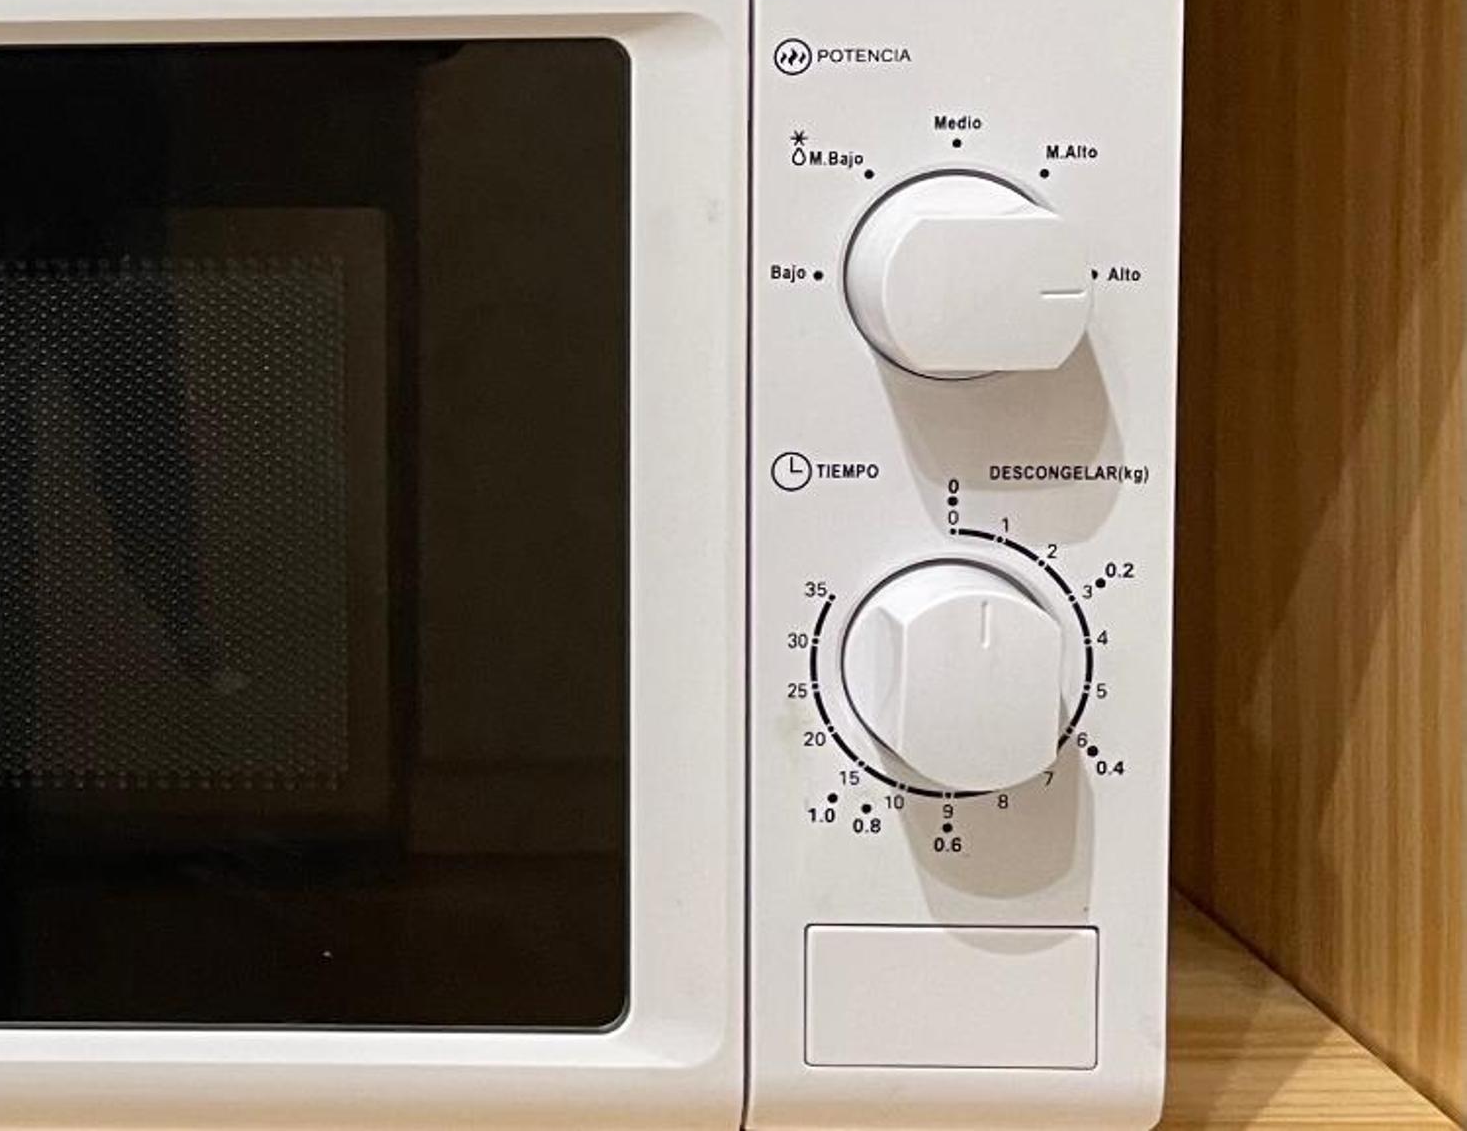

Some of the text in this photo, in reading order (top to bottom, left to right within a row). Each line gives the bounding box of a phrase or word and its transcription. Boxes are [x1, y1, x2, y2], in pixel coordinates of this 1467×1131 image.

[817, 49, 911, 63] POTENCIA
[934, 116, 982, 130] Medio
[810, 152, 864, 166] M.Bajo
[1046, 145, 1098, 159] M.Alto
[771, 266, 806, 281] Bajo
[1107, 268, 1141, 282] Alto
[817, 464, 879, 478] TIEMPO
[990, 465, 1149, 483] DESCONGELAR(kg)
[948, 480, 959, 494] 0
[948, 511, 959, 525] 0
[1002, 519, 1009, 531] 1
[1047, 545, 1057, 559] 2
[1105, 563, 1135, 578] 0.2
[805, 582, 827, 597] 35
[1083, 585, 1093, 599] 3
[788, 634, 808, 648] 30
[1097, 631, 1108, 645] 4
[788, 684, 808, 698] 25
[1097, 684, 1107, 698] 5
[804, 732, 826, 747] 20
[1077, 733, 1088, 748] 6
[1096, 761, 1124, 775] 0.4
[840, 771, 860, 785] 15
[1043, 771, 1054, 786] 7
[885, 795, 904, 810] 10
[998, 795, 1008, 809] 8
[808, 808, 836, 823] 1.0
[942, 805, 953, 819] 9
[853, 819, 881, 833] 0.8
[934, 838, 962, 852] 0.6
